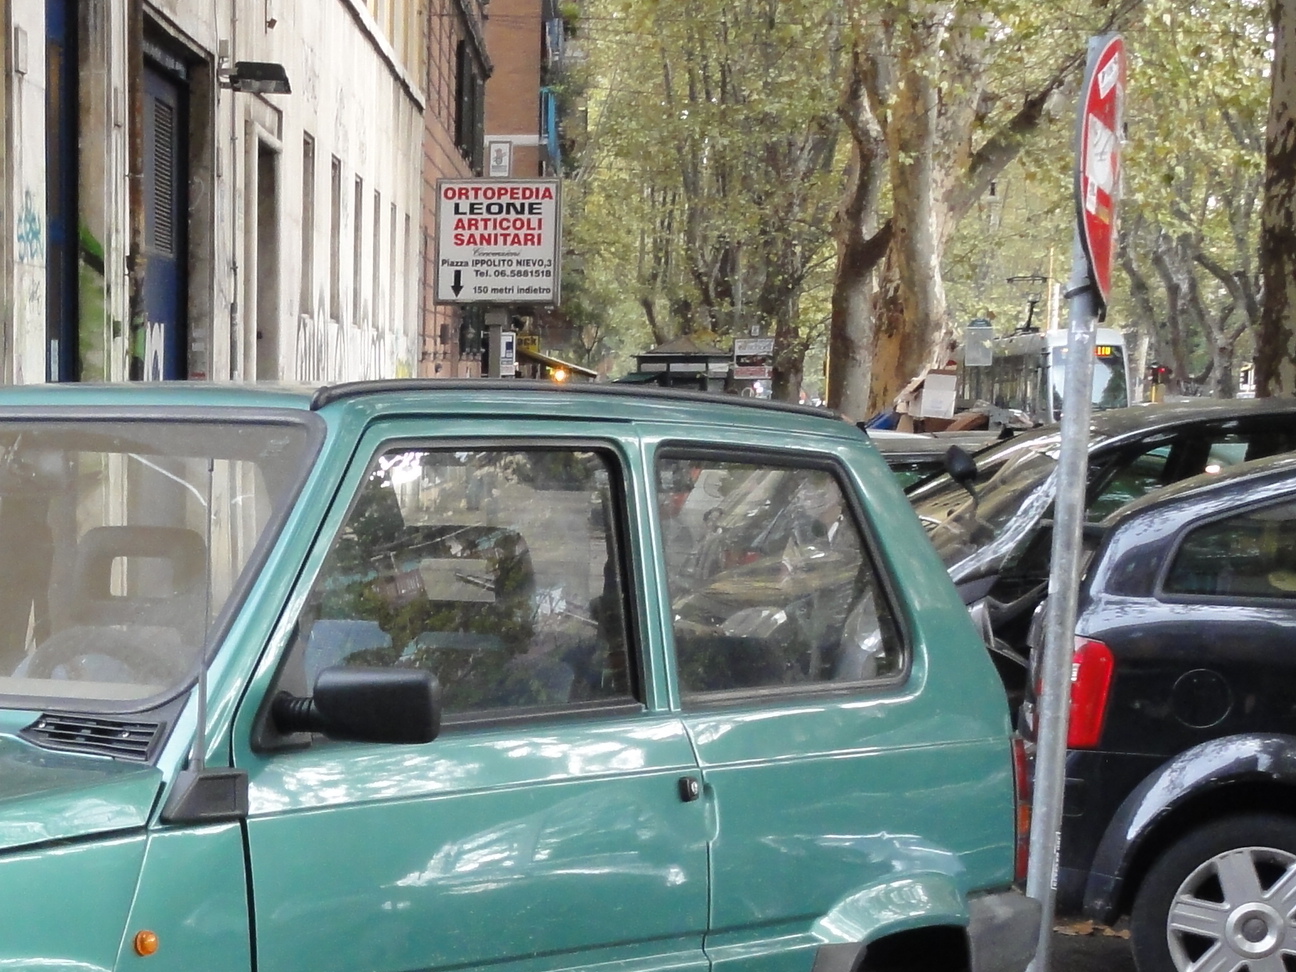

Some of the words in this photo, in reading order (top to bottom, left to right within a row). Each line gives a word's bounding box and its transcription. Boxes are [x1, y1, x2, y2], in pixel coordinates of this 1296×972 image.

[443, 187, 553, 200] ORTOPEDIA
[454, 202, 542, 215] LEONE
[454, 217, 542, 231] ARTICOLI
[453, 233, 542, 246] SANITARI
[441, 259, 469, 267] Piazza
[471, 259, 513, 267] IPPOLITO
[474, 269, 491, 277] Tel.
[473, 286, 488, 294] 150
[491, 286, 514, 294] metri
[517, 286, 551, 294] indietro
